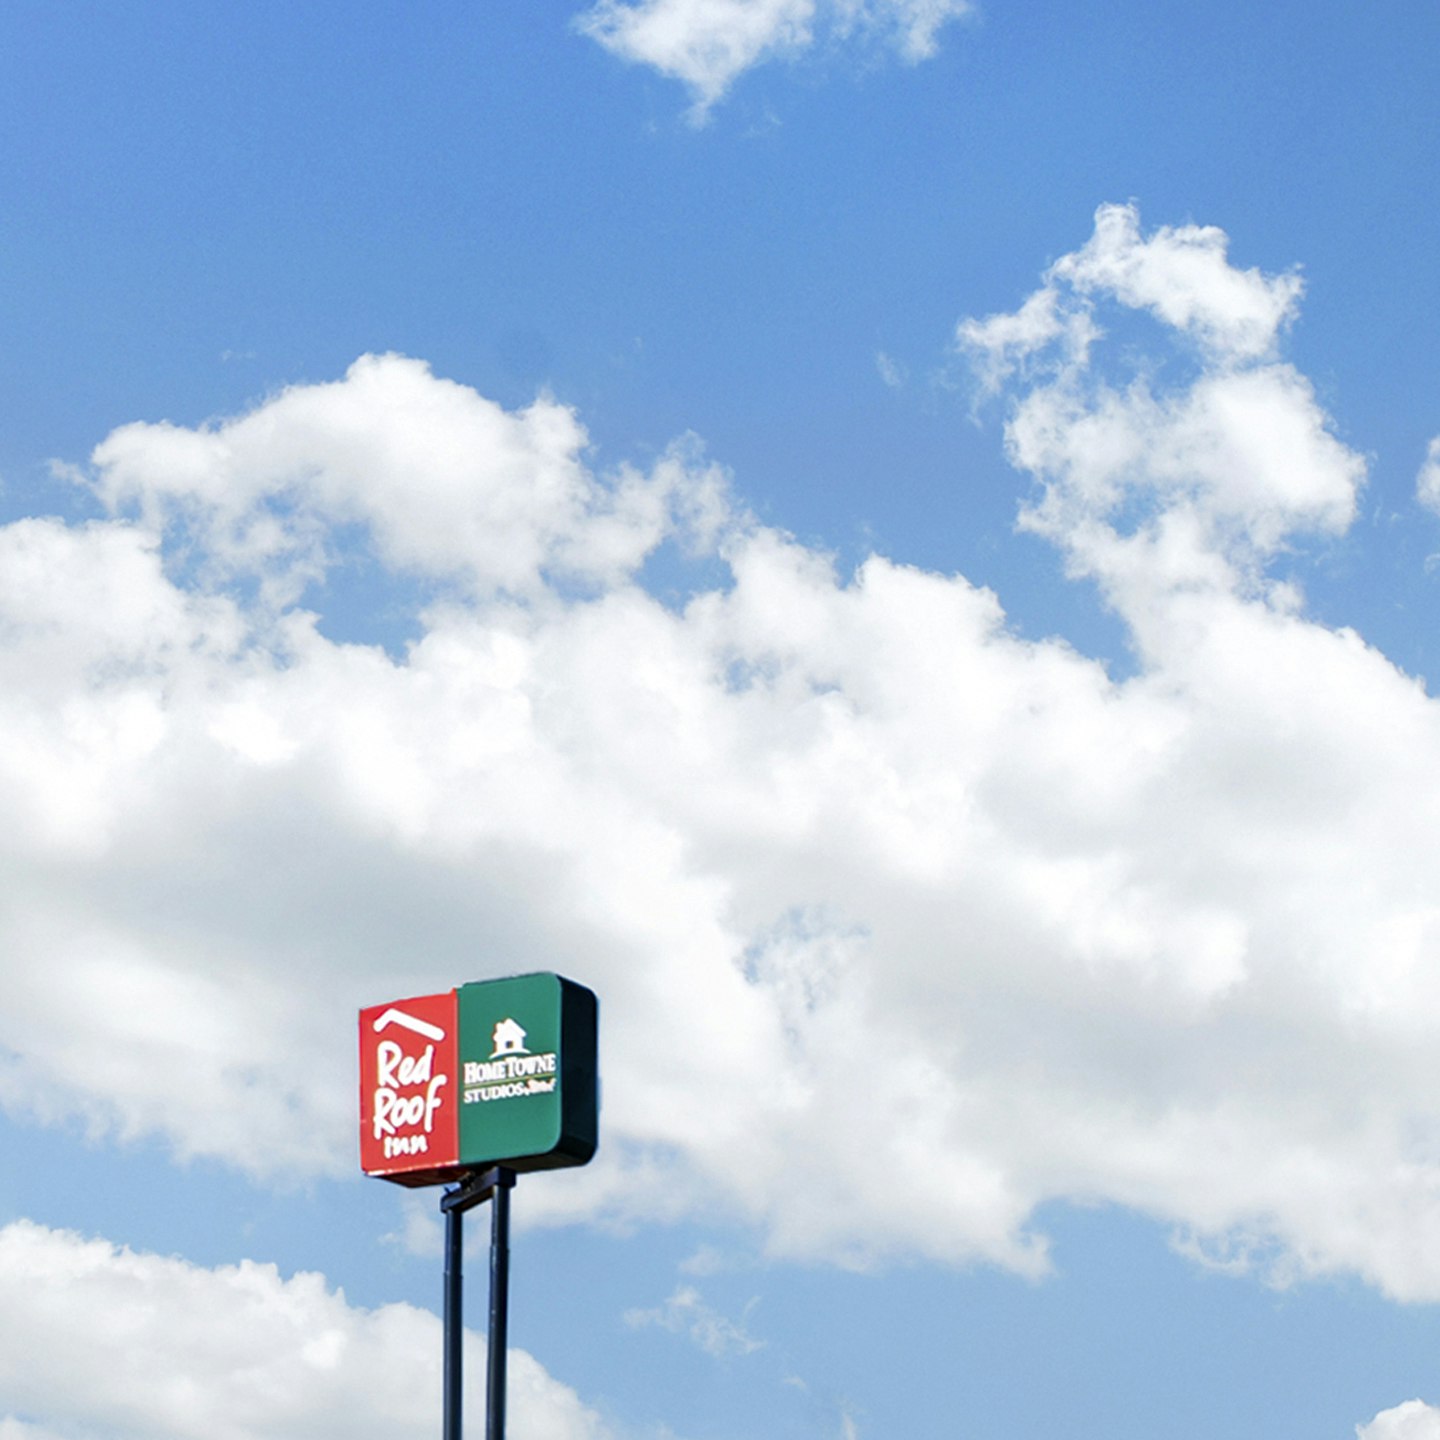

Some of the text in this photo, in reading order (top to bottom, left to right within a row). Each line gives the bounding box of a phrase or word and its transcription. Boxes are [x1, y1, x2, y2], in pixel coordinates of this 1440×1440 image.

[377, 1040, 434, 1089] Red
[374, 1074, 447, 1140] Roof
[464, 1082, 524, 1104] STUDIOS
